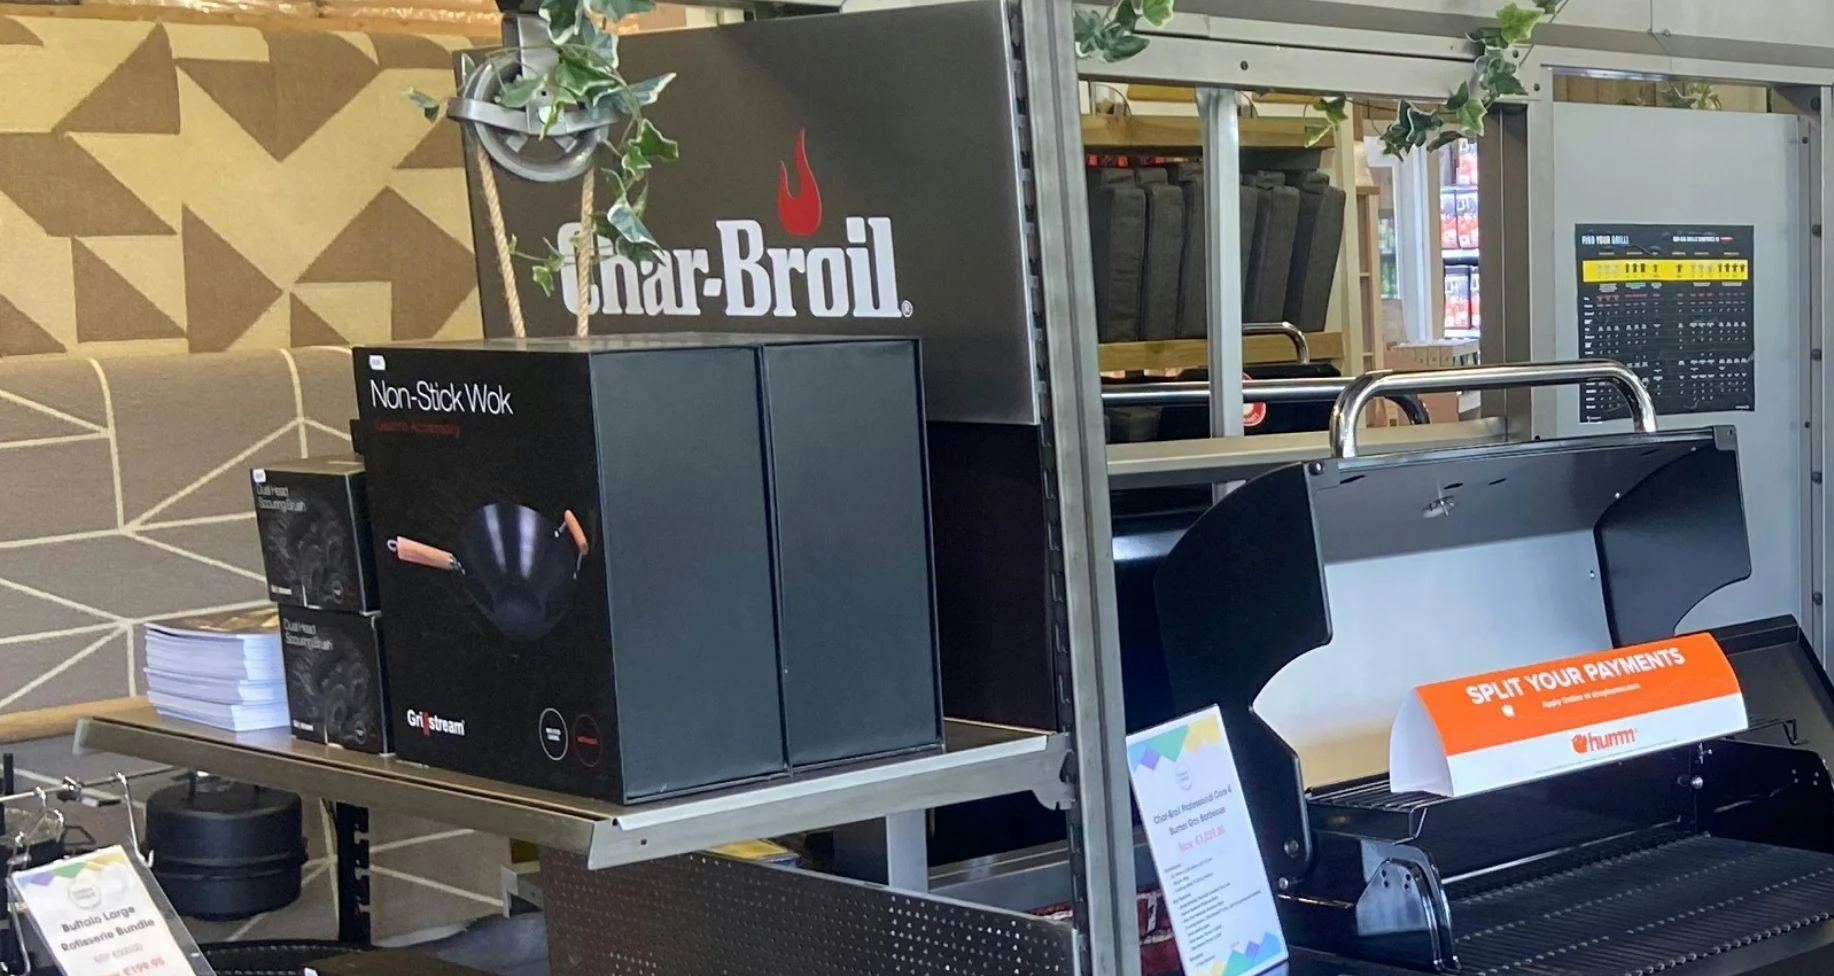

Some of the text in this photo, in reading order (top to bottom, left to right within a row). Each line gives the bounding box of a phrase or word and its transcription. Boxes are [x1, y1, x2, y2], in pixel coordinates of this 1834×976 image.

[370, 380, 514, 415] Non-Stick Wok
[1465, 647, 1685, 705] SPLIT YOUR PAYMENTS
[1588, 728, 1635, 752] humm
[60, 917, 156, 952] Rotisserie Bundle
[61, 905, 136, 933] Buffalo Large
